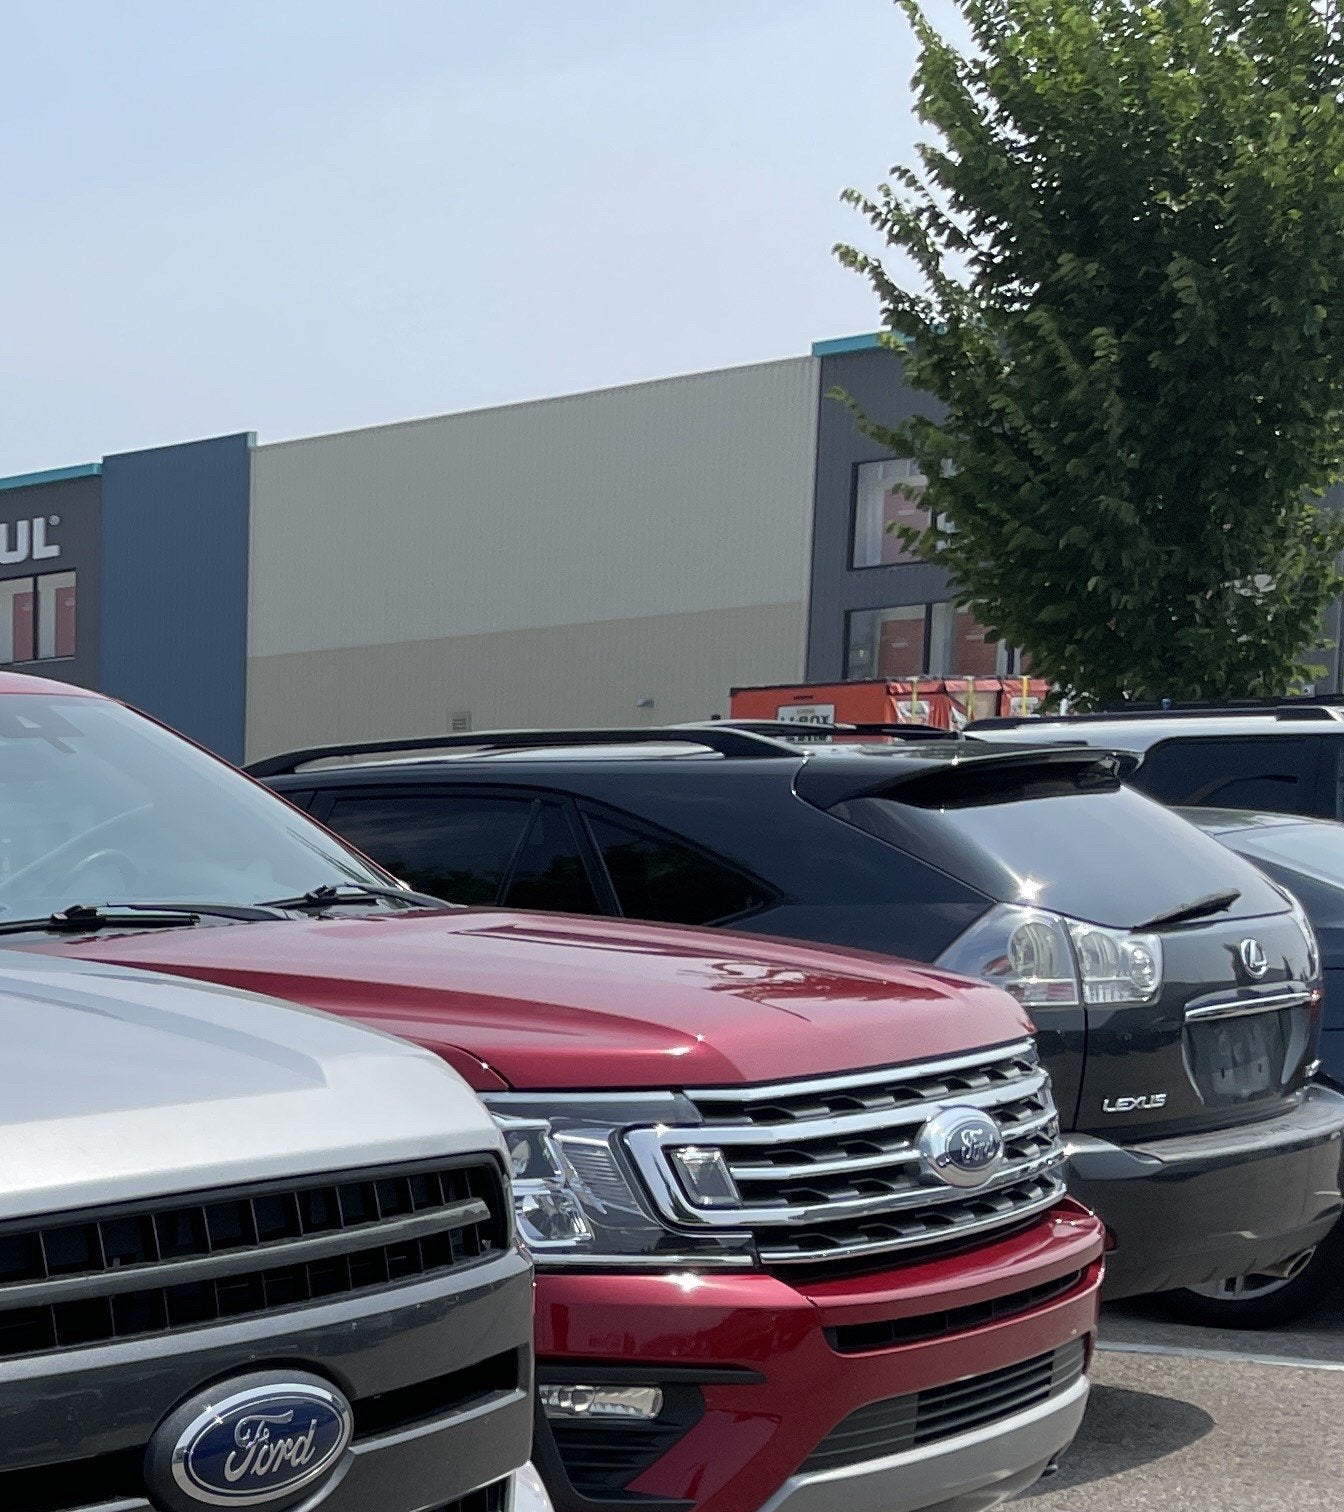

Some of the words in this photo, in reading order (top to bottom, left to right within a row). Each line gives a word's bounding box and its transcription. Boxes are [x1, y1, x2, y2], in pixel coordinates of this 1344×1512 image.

[1102, 1093, 1167, 1113] LEXUS
[960, 1128, 997, 1163] Ford
[223, 1409, 318, 1483] Ford
